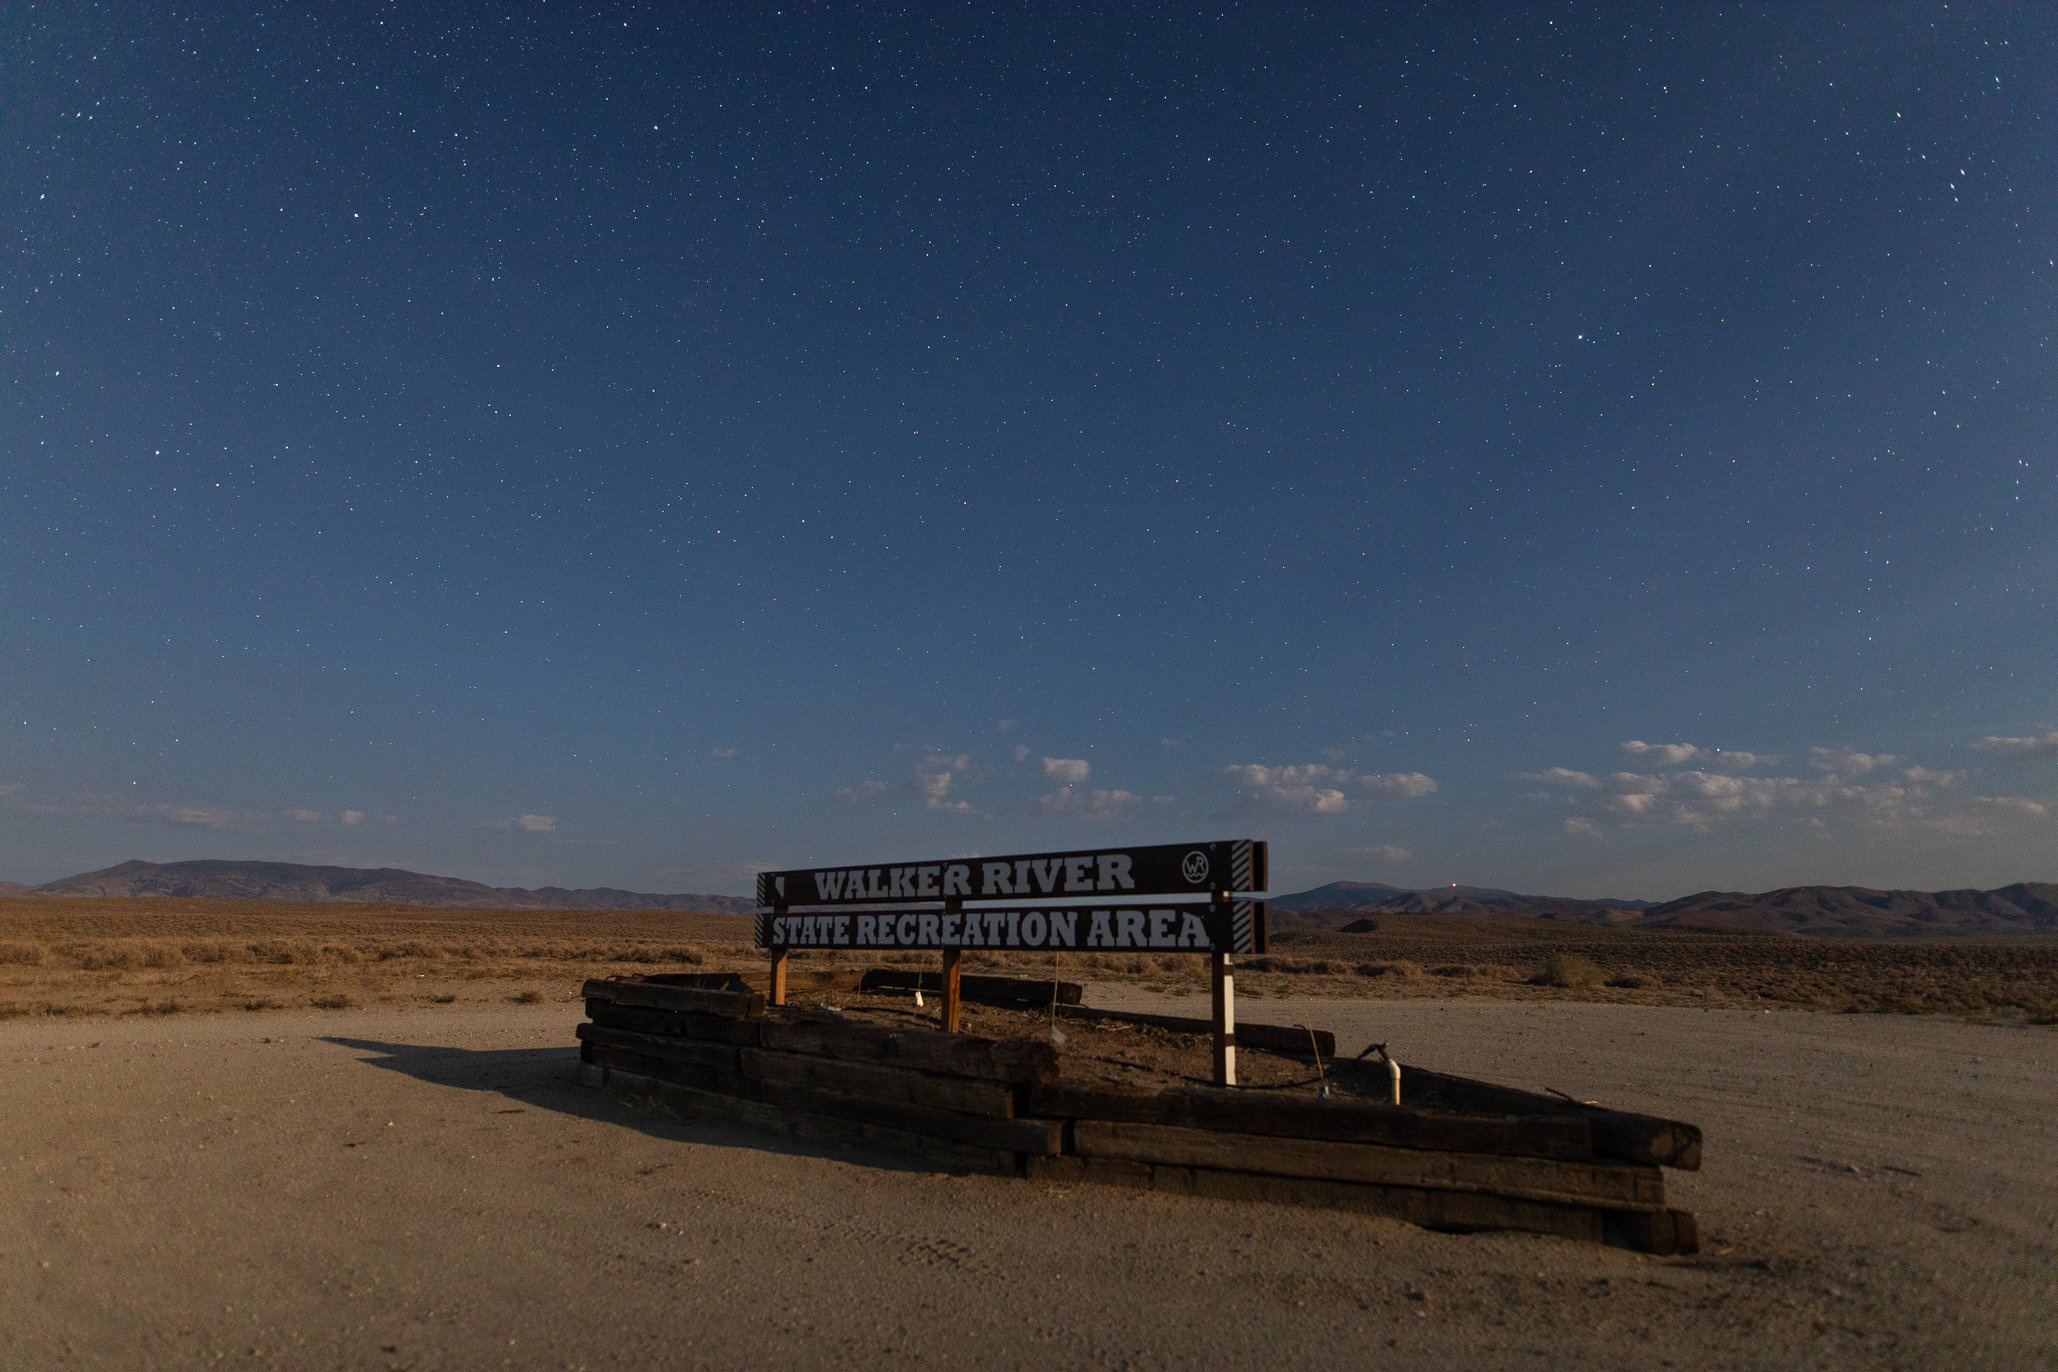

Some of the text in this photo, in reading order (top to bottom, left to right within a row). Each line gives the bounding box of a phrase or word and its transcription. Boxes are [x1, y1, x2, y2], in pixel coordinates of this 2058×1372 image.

[814, 854, 1135, 901] WALKER RIVER
[773, 909, 1210, 947] STATE RECREATION AREA
